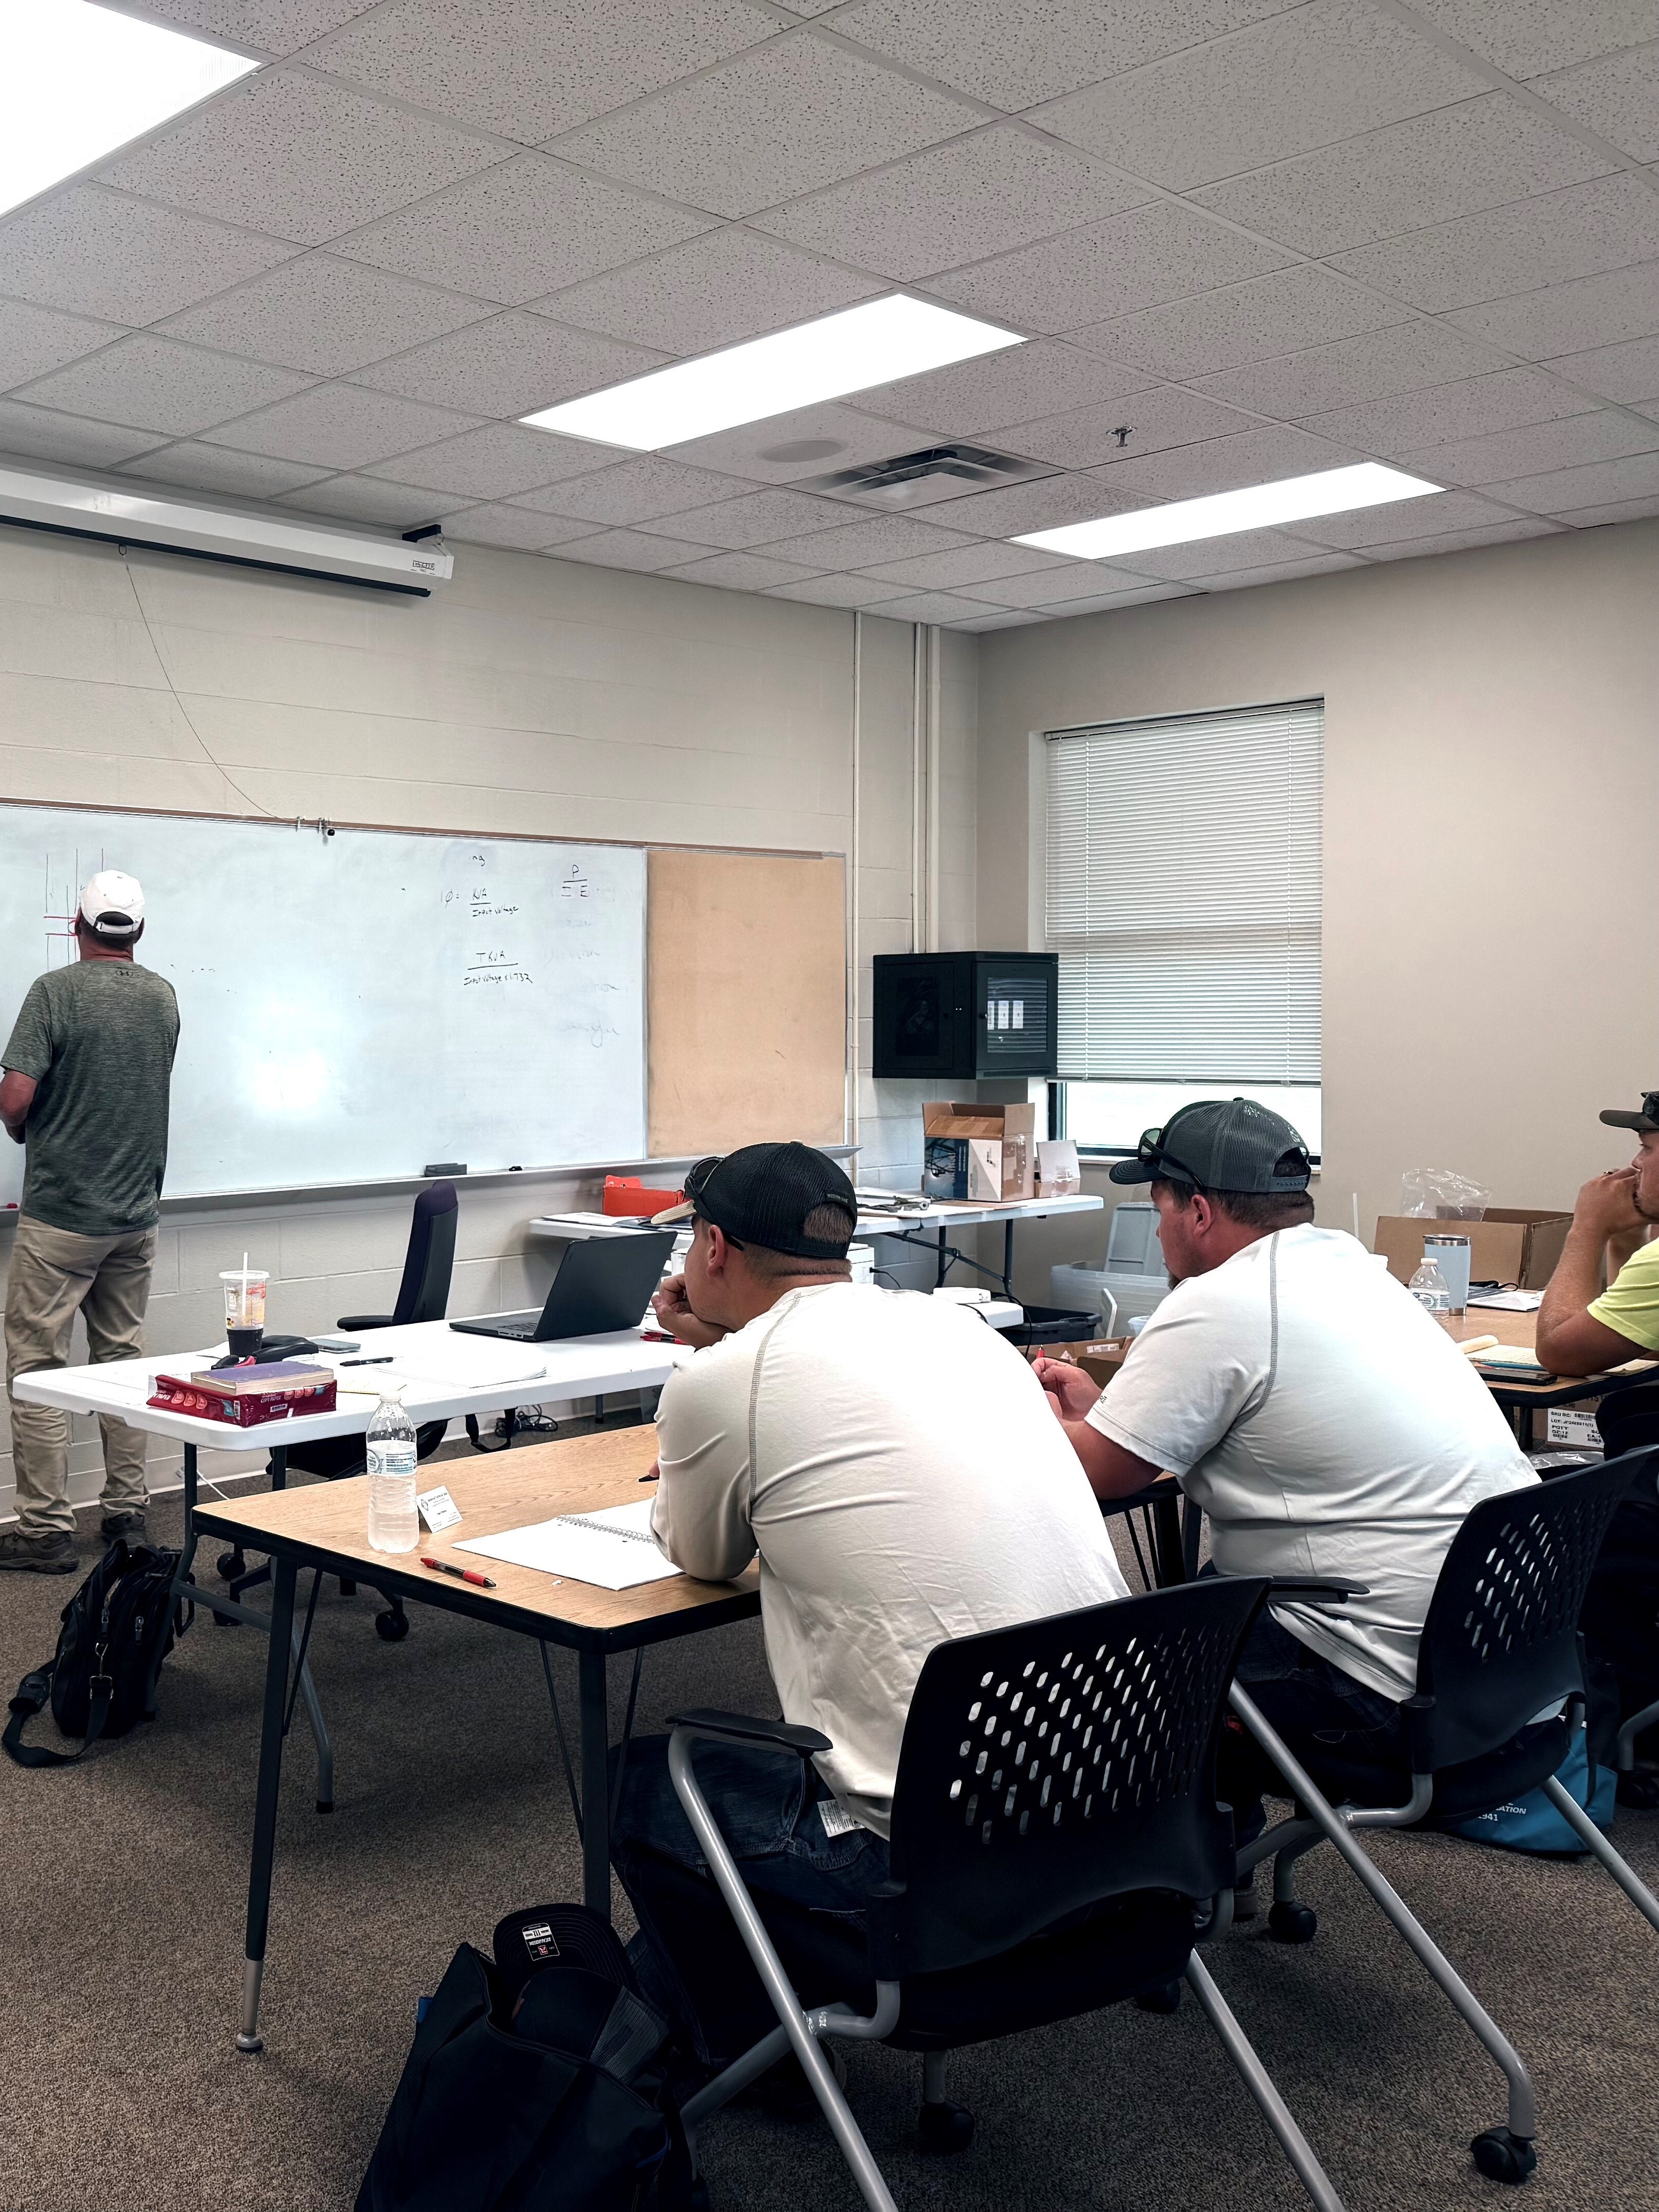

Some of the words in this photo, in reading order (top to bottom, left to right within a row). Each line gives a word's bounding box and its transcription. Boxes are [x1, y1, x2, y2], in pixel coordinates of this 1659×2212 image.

[571, 864, 579, 879] P
[472, 888, 487, 900] KVA
[580, 885, 589, 897] E
[1496, 1806, 1527, 1814] ATION
[1477, 1813, 1498, 1821] 941
